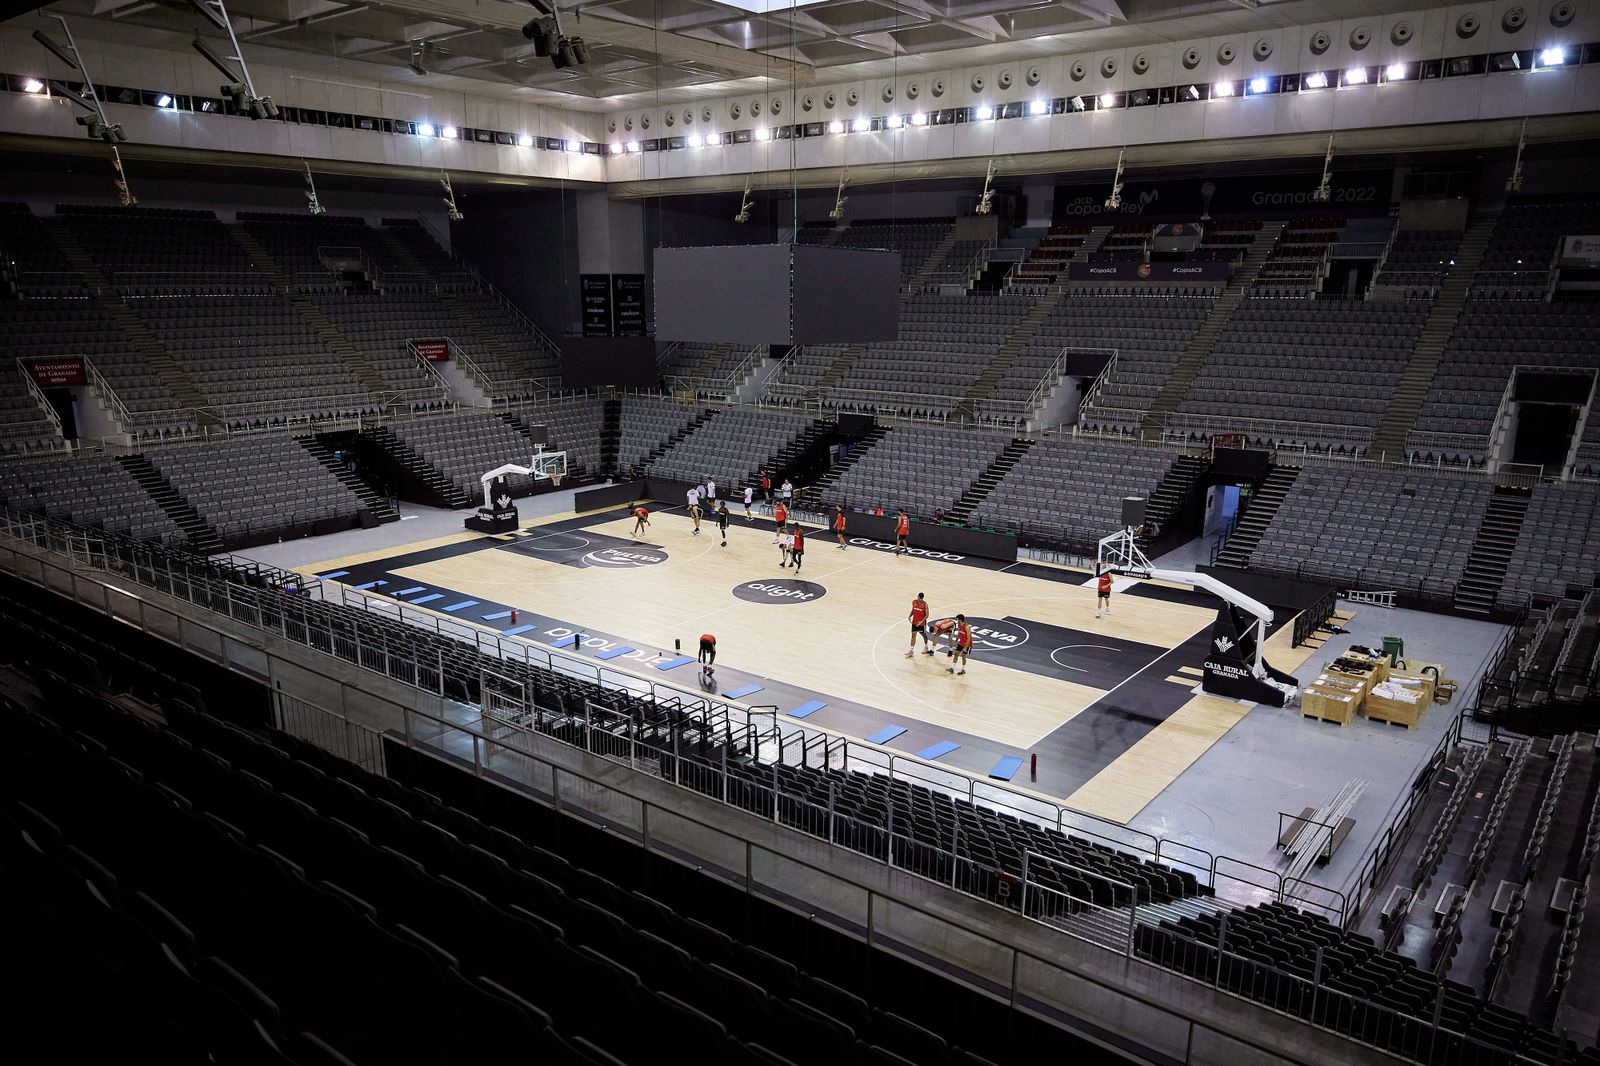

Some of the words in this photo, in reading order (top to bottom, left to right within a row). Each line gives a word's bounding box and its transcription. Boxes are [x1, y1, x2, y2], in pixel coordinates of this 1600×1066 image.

[1073, 195, 1095, 206] acb
[1334, 186, 1376, 203] 2022
[1066, 202, 1103, 216] Copa
[1120, 201, 1147, 217] Rey
[34, 364, 80, 372] AYUNTAMIENTO
[48, 370, 78, 378] GRANADA
[849, 537, 966, 561] Granada
[747, 583, 816, 600] alight
[1203, 661, 1223, 672] CAJA
[1223, 664, 1250, 678] RURAL
[1212, 669, 1240, 680] GRANADA
[997, 879, 1011, 898] B
